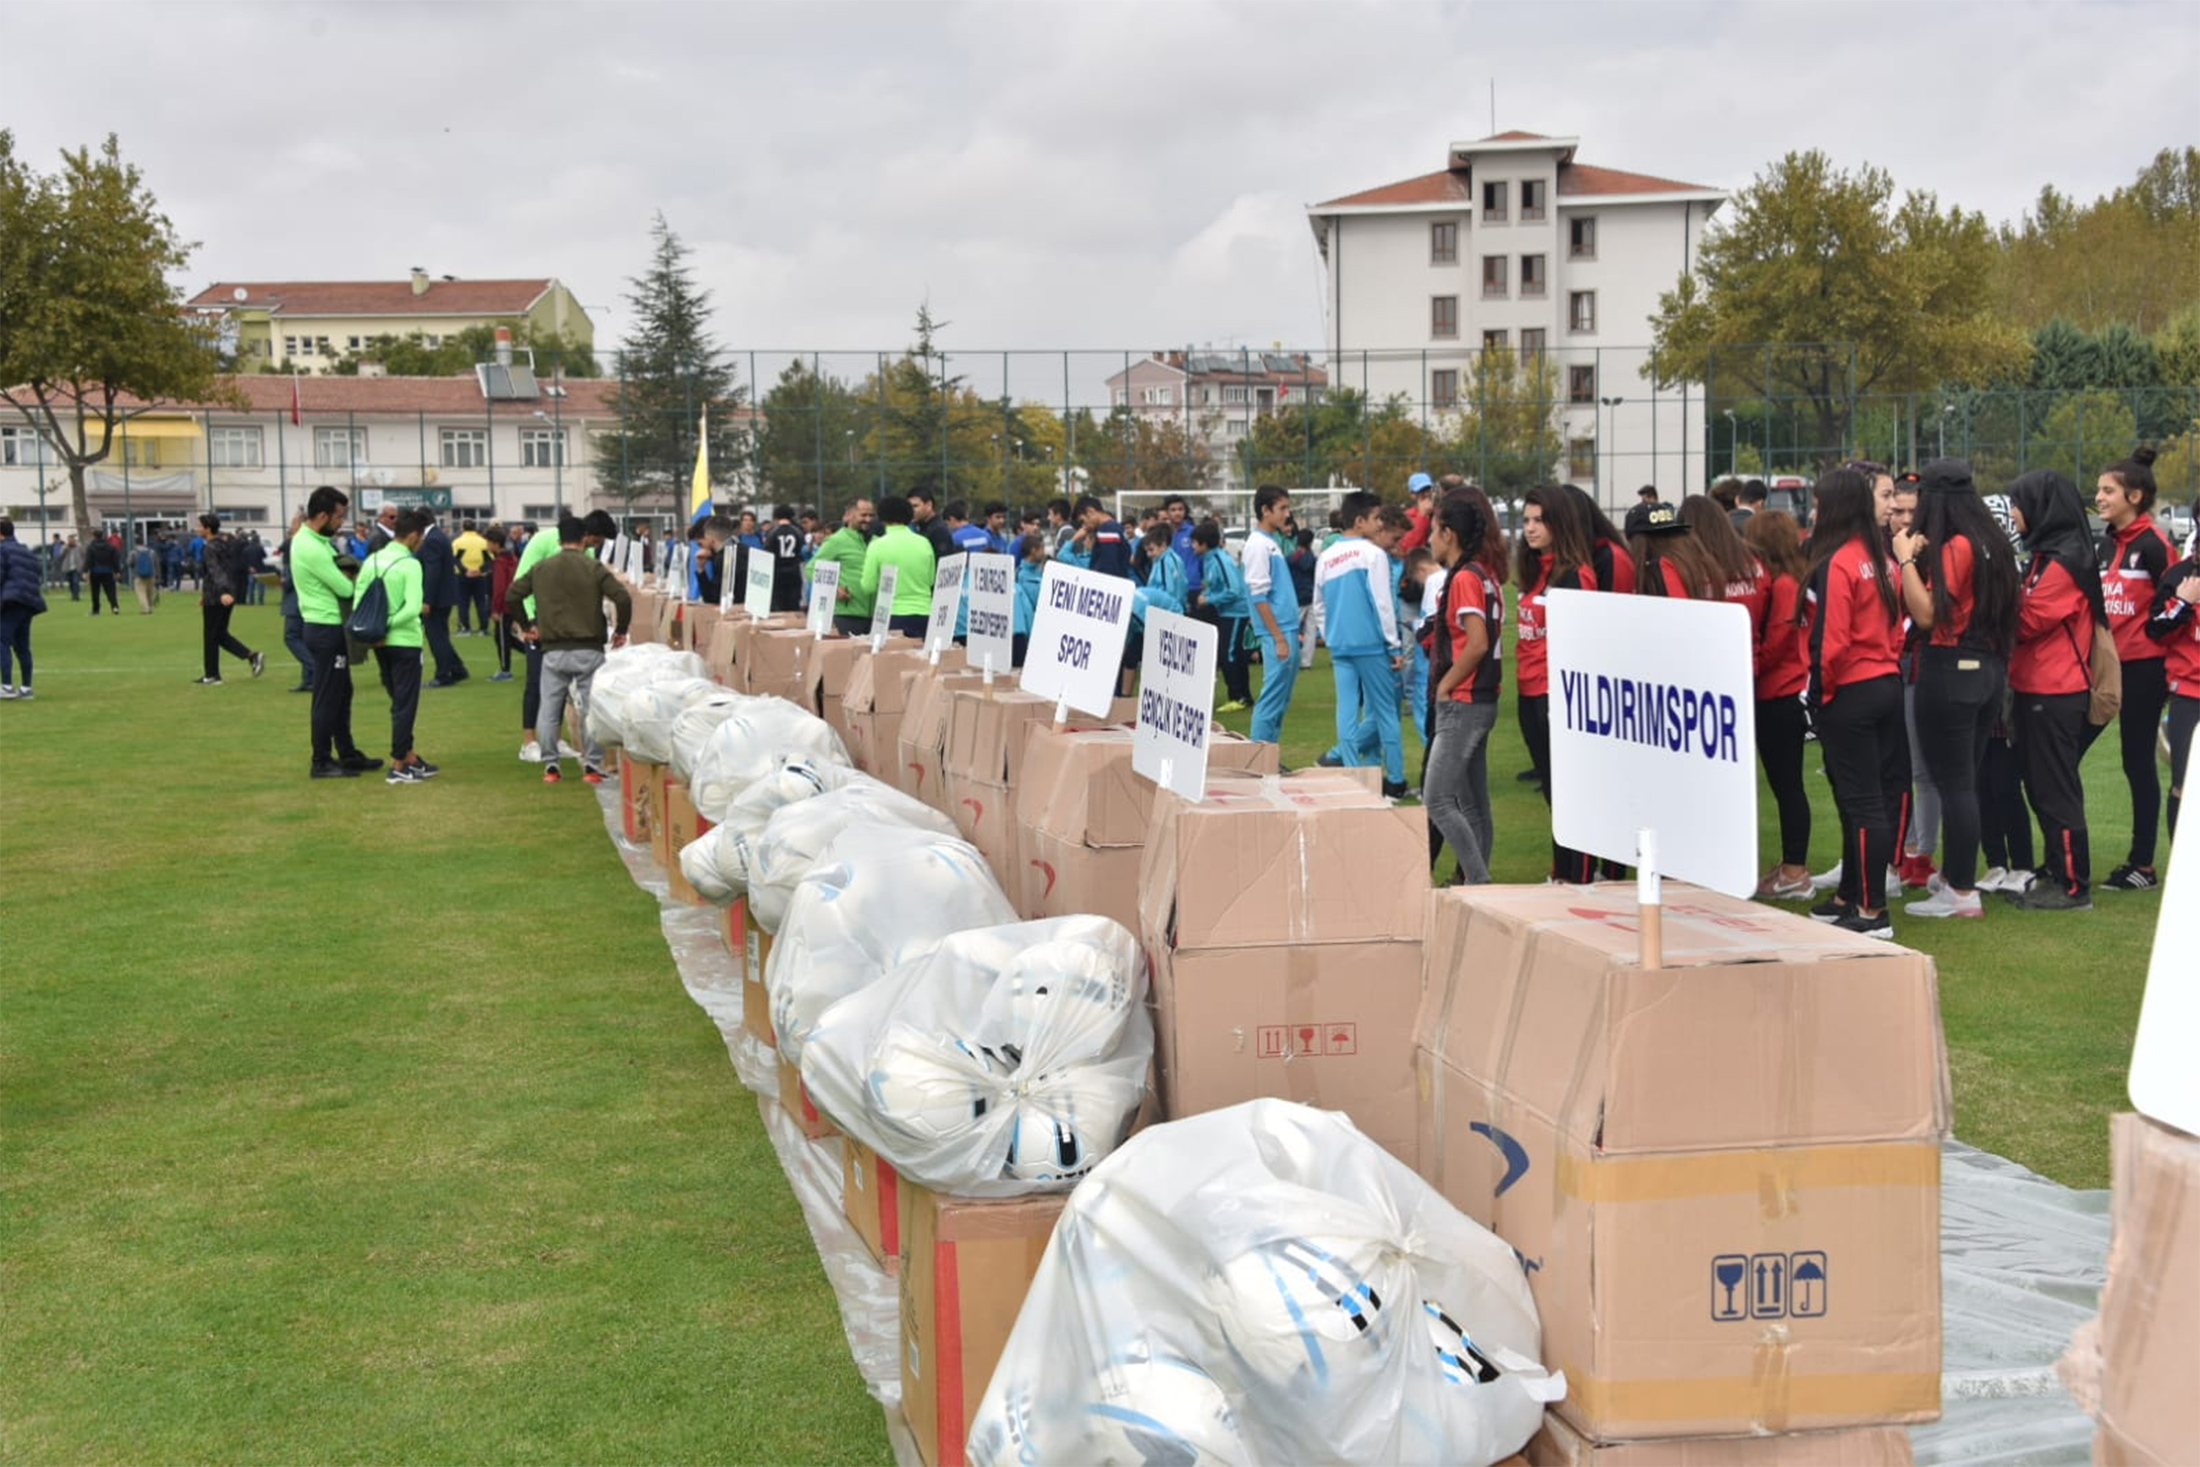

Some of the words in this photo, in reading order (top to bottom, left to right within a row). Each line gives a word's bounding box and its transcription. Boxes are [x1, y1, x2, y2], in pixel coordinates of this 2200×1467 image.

[778, 535, 796, 558] 12
[1050, 576, 1078, 612] YENİ
[1077, 586, 1123, 625] MERAM
[1057, 634, 1092, 671] SPOR
[1159, 623, 1197, 677] YEŞİLYURT
[1141, 687, 1173, 739] GENÇLİK
[1172, 698, 1183, 739] VE
[1182, 704, 1205, 750] SPOR
[1561, 669, 1738, 763] YILDIRIMSPOR
